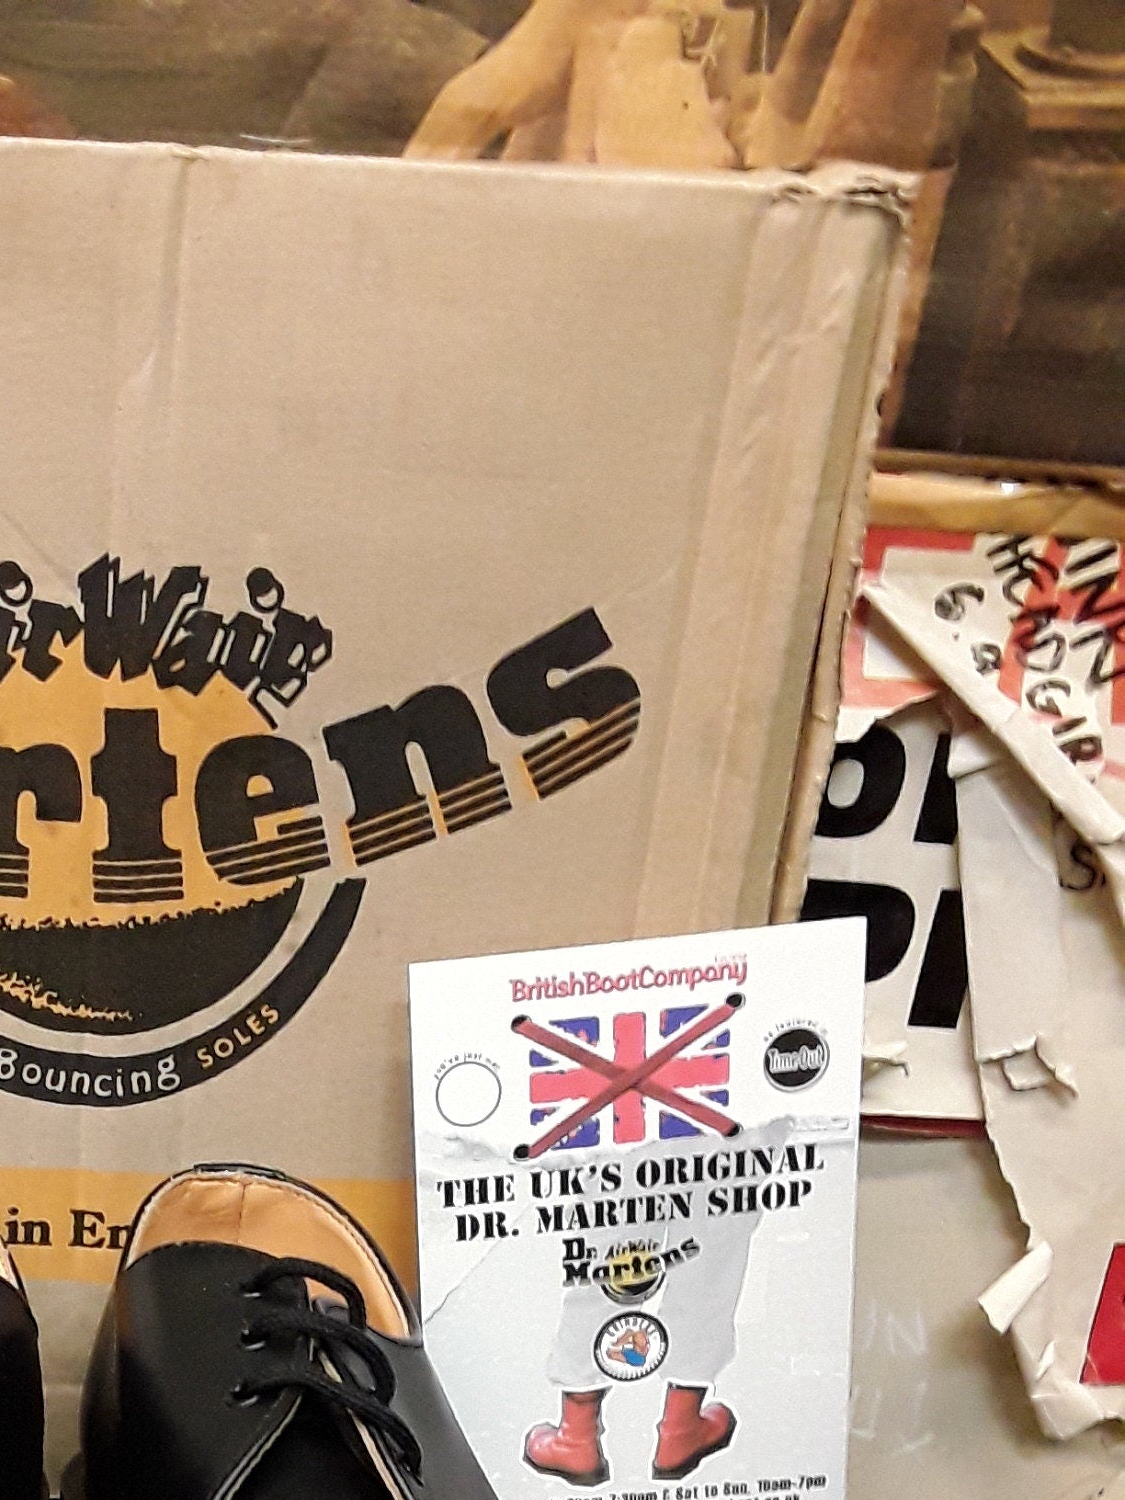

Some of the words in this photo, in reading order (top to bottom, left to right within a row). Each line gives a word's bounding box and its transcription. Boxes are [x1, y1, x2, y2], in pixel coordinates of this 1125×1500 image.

[196, 1003, 280, 1069] SOLES
[436, 1174, 515, 1209] THE
[530, 1161, 622, 1200] UK'S
[635, 1143, 825, 1188] ORIGINAL
[5, 1207, 52, 1247] in
[455, 1209, 520, 1243] DR.
[535, 1191, 695, 1236] MARTEN
[707, 1179, 813, 1217] SHOP
[563, 1235, 702, 1288] Martens
[676, 1486, 699, 1500] Sat
[704, 1484, 719, 1498] to
